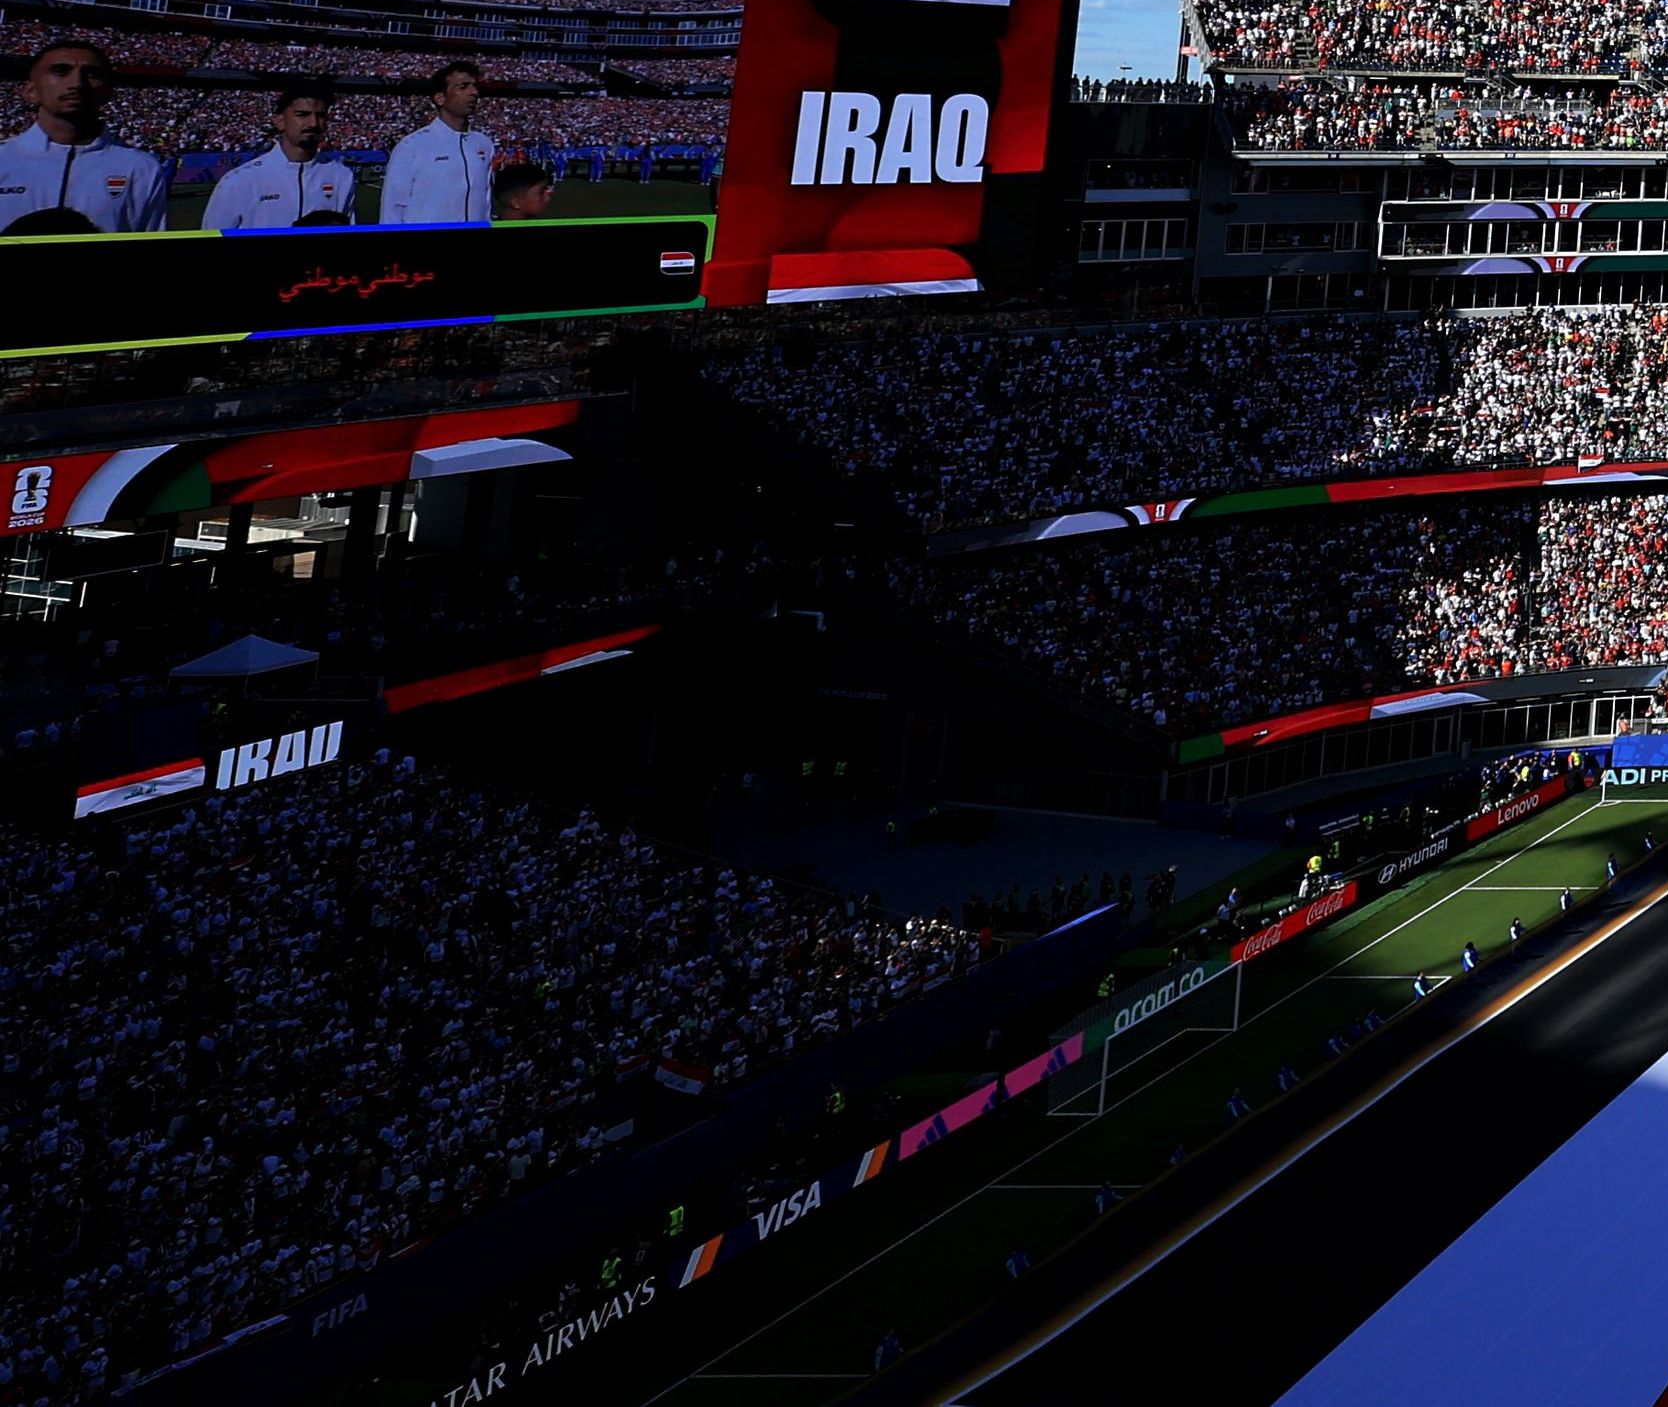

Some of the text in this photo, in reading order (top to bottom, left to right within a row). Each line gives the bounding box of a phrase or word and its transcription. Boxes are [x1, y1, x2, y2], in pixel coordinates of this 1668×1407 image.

[790, 90, 989, 185] IRAQ
[8, 516, 44, 529] 2026
[1601, 768, 1645, 785] ADI
[1497, 793, 1540, 825] Lenovo
[1399, 838, 1449, 873] HYUNDAI
[1113, 966, 1205, 1034] aramco
[750, 1180, 822, 1241] VISA
[312, 1293, 370, 1340] FIFA
[428, 1275, 656, 1407] TAR AIRWAYS
